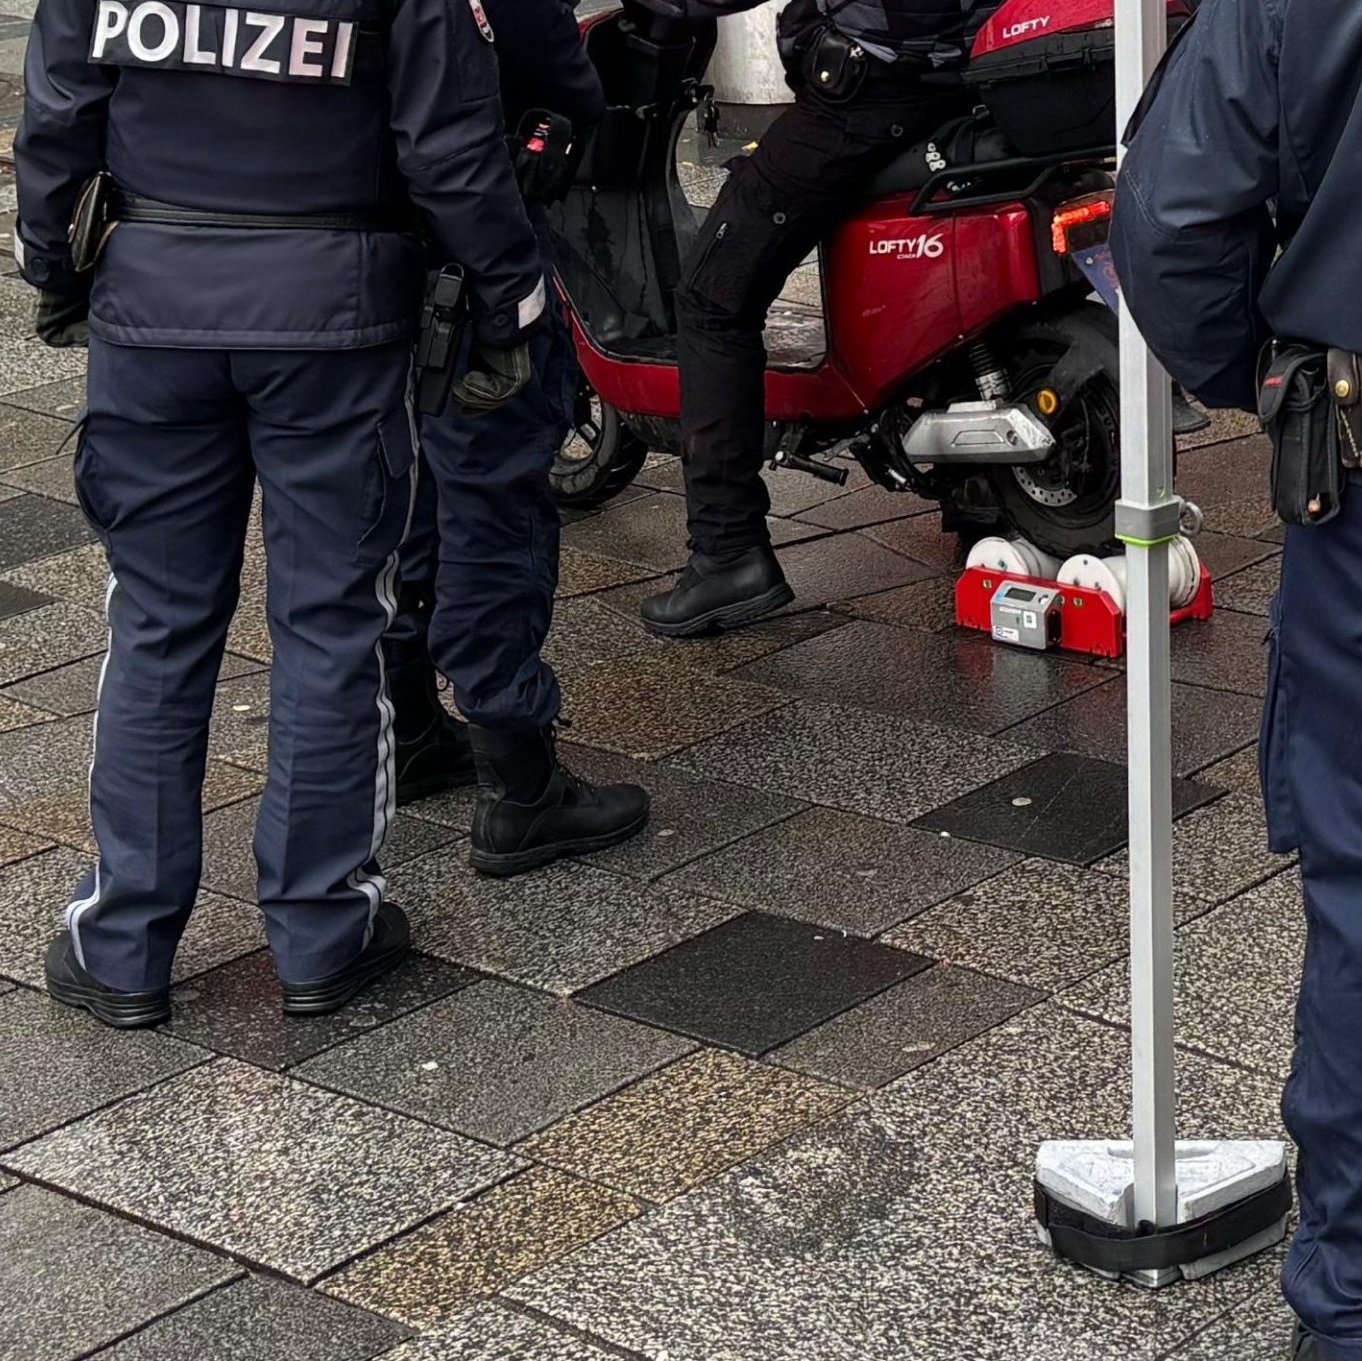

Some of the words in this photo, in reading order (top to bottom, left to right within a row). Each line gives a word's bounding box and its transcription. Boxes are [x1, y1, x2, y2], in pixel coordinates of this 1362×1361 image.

[93, 0, 353, 78] POLIZEI
[1002, 15, 1050, 39] LOFTY
[869, 238, 917, 255] LOFTY
